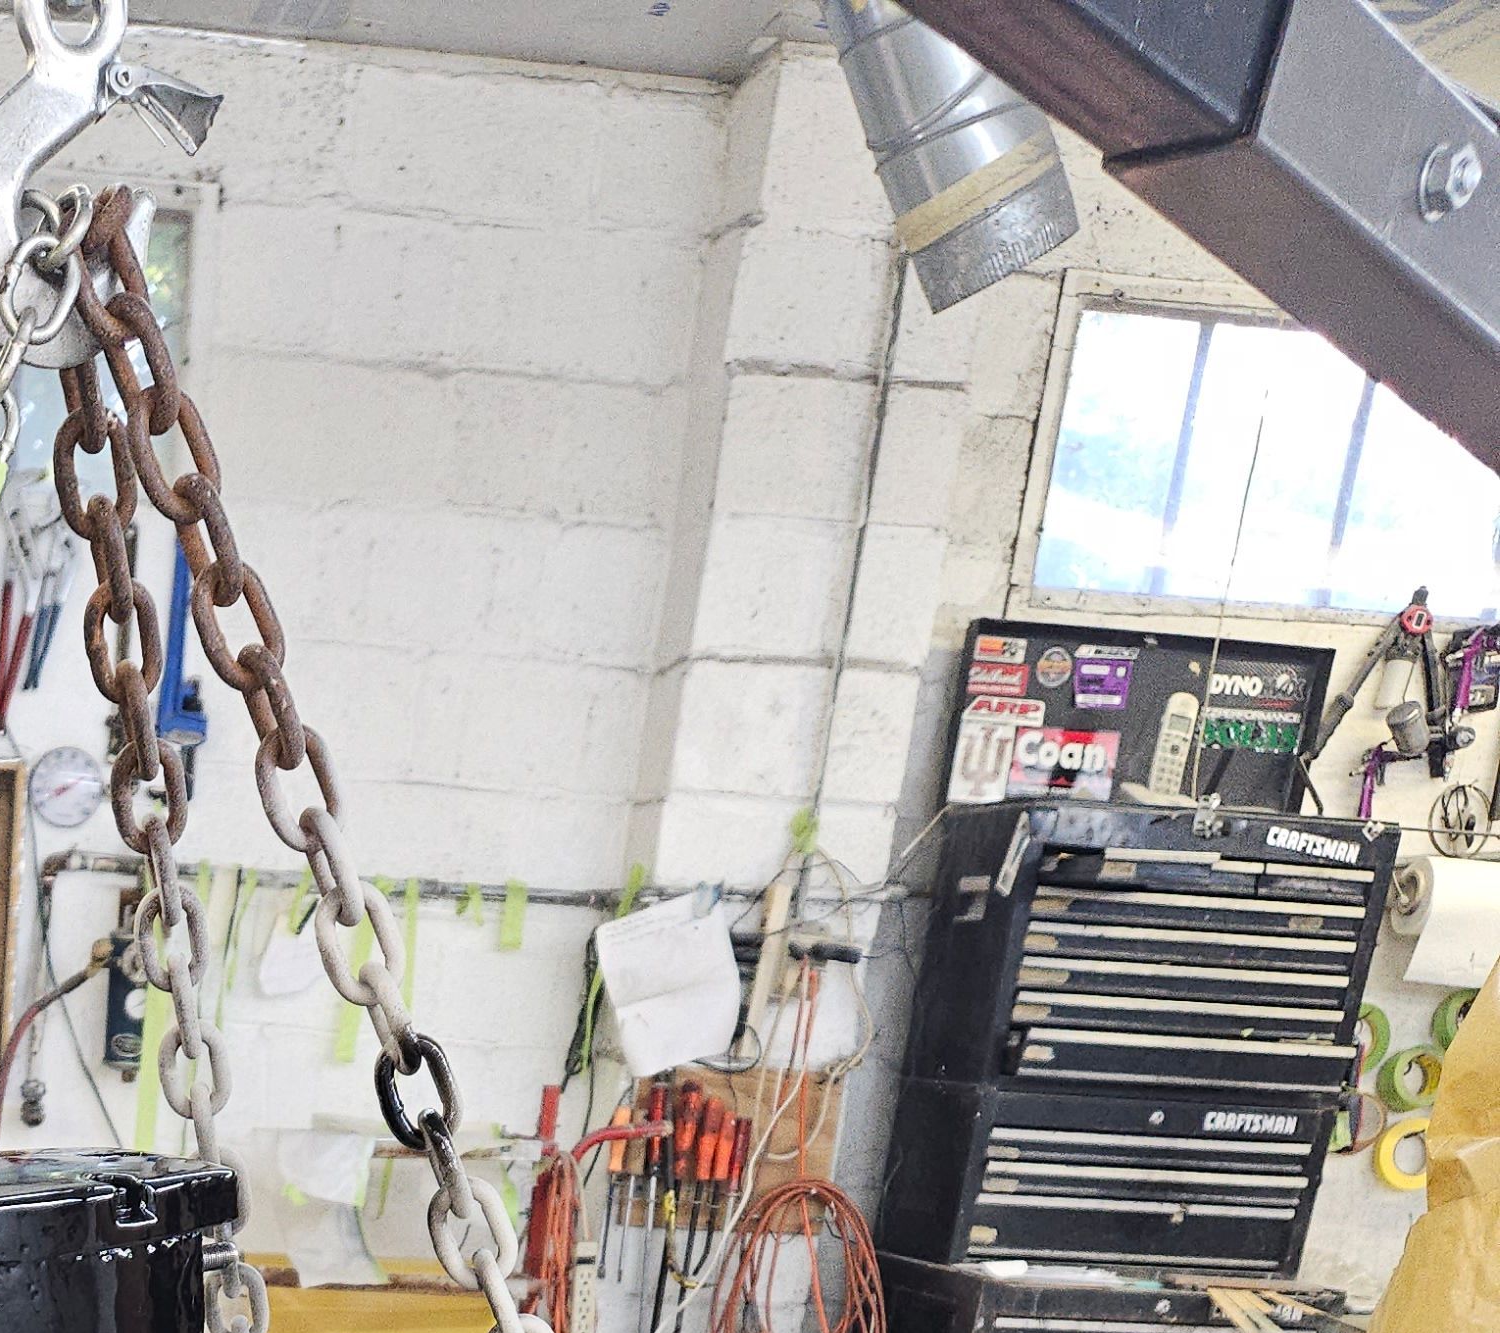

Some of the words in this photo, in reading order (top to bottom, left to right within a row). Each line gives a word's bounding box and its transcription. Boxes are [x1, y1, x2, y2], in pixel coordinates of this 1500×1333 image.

[971, 699, 1041, 715] ARP
[1017, 731, 1106, 771] Coan
[1266, 826, 1361, 864] CRAFTSMAN
[1203, 1111, 1298, 1136] CRAFTSMAN
